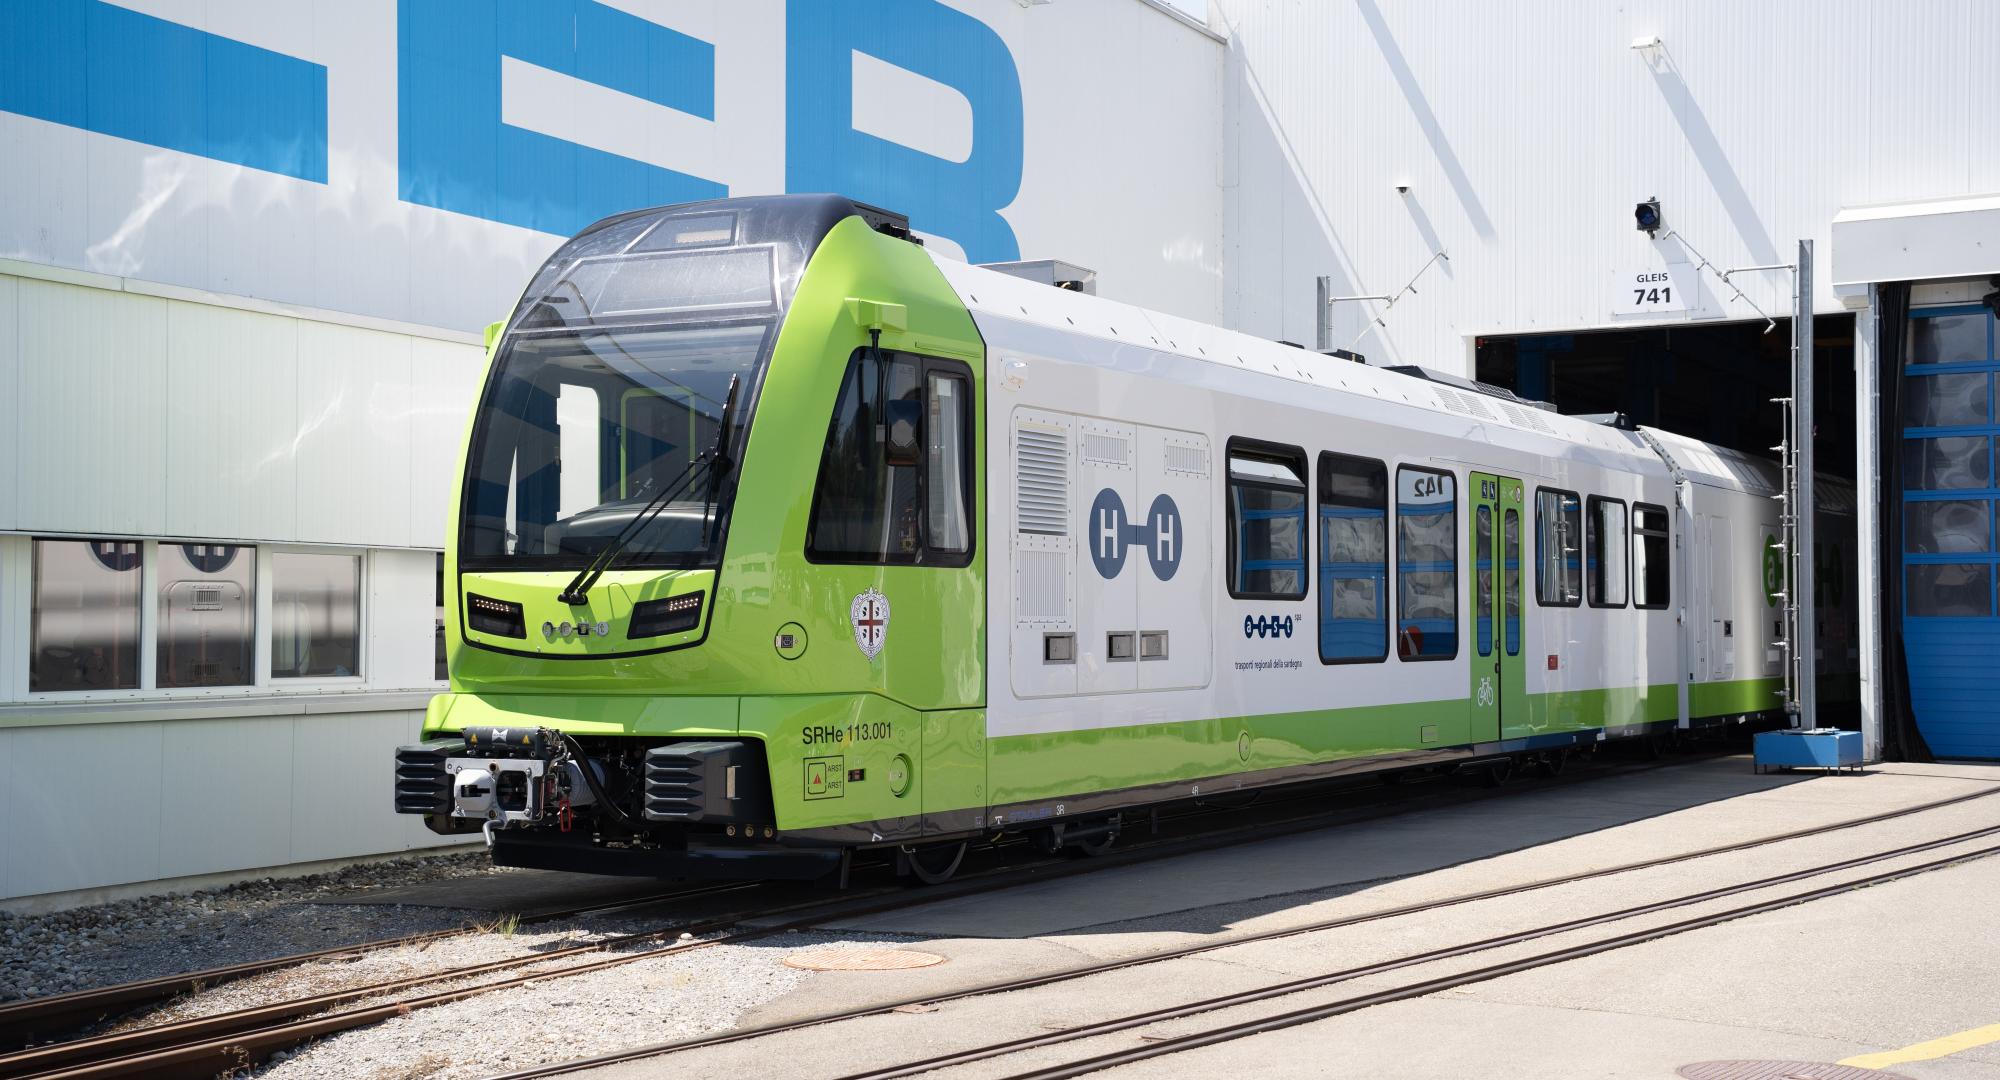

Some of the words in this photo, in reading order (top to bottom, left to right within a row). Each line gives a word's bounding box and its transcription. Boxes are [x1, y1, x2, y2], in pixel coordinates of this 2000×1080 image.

[1636, 272, 1668, 283] GLEIS
[1633, 287, 1671, 305] 741
[1245, 619, 1291, 634] arst
[802, 725, 843, 744] SRHe
[847, 721, 891, 741] 113.001
[827, 764, 842, 773] ARST
[827, 781, 842, 789] ARST
[1056, 803, 1065, 816] 3R
